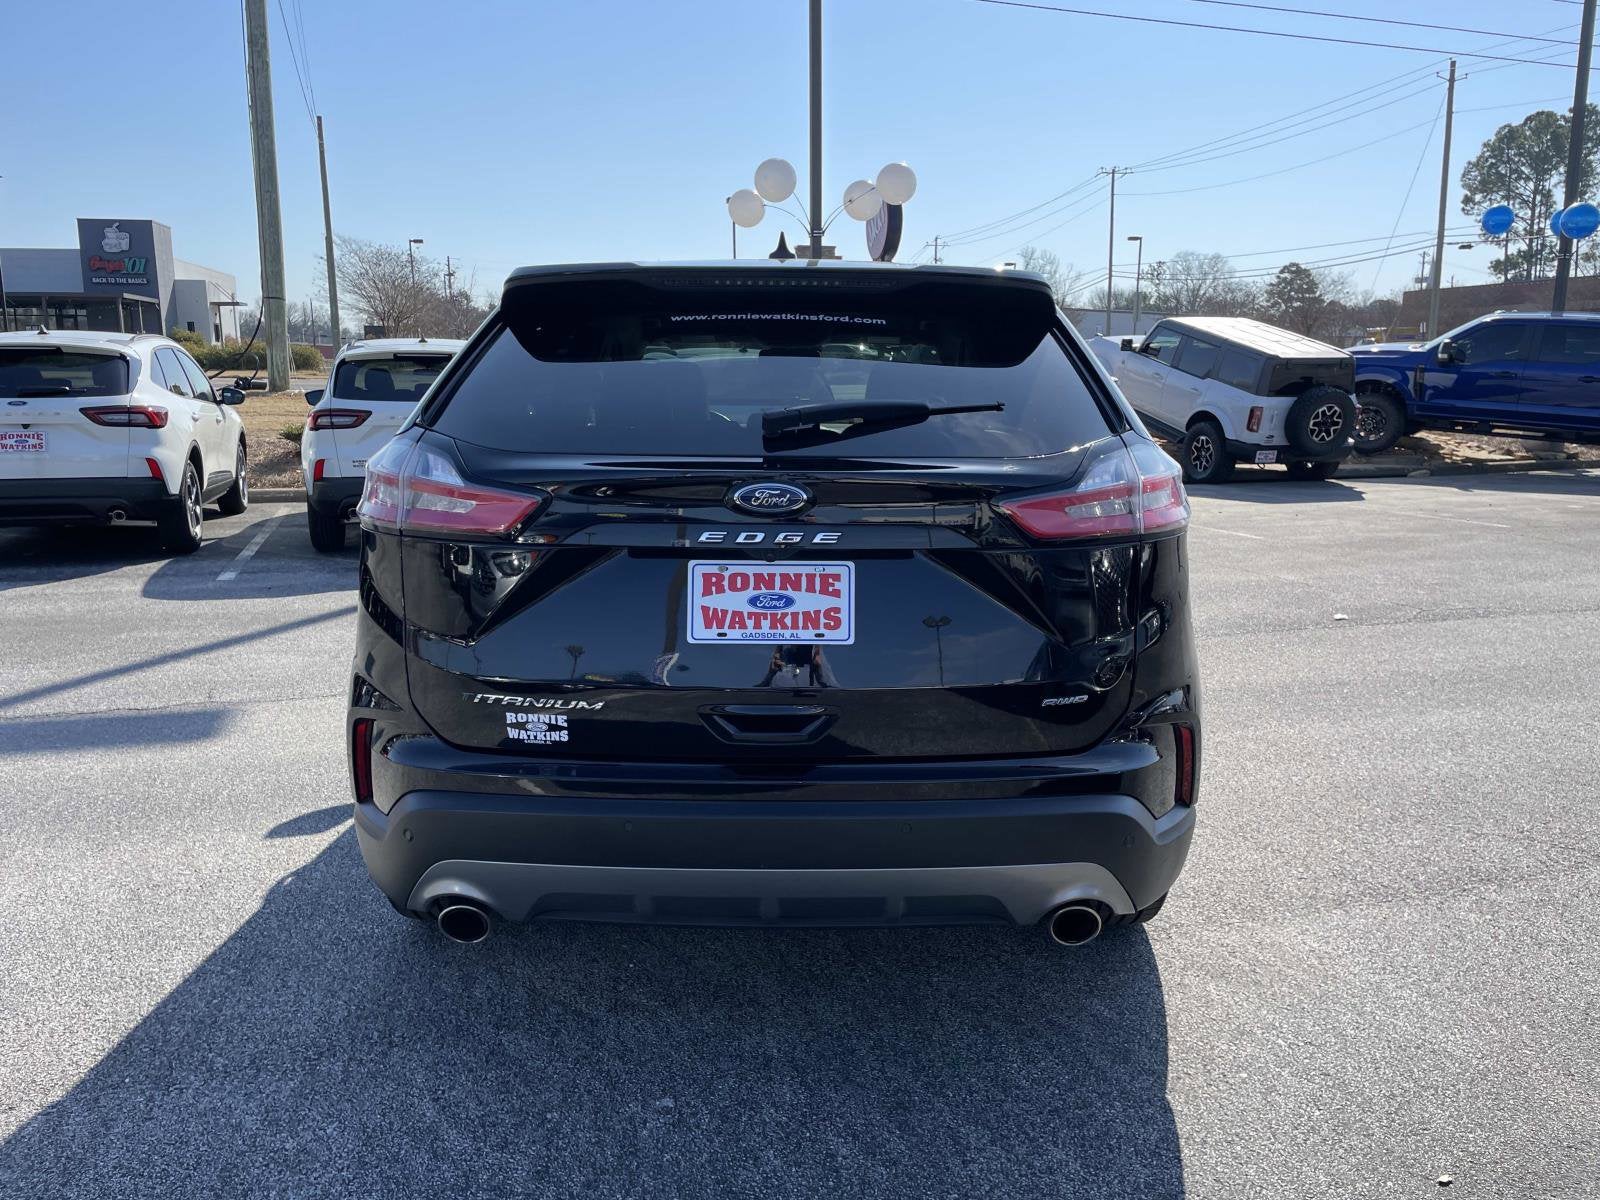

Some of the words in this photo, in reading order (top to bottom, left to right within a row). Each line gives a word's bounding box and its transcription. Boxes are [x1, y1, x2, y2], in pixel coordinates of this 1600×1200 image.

[670, 312, 887, 325] www.ronniewatkinsford.com
[0, 433, 43, 441] RONNIE
[0, 442, 44, 450] WATKINS
[751, 488, 790, 506] Ford
[697, 531, 843, 544] EDGE
[701, 572, 842, 599] RONNIE
[700, 605, 842, 631] WATKINS
[741, 632, 788, 640] GADSDEN,
[463, 692, 606, 711] TITANIUM
[505, 712, 568, 728] RONNIE
[506, 727, 569, 742] WATKINS
